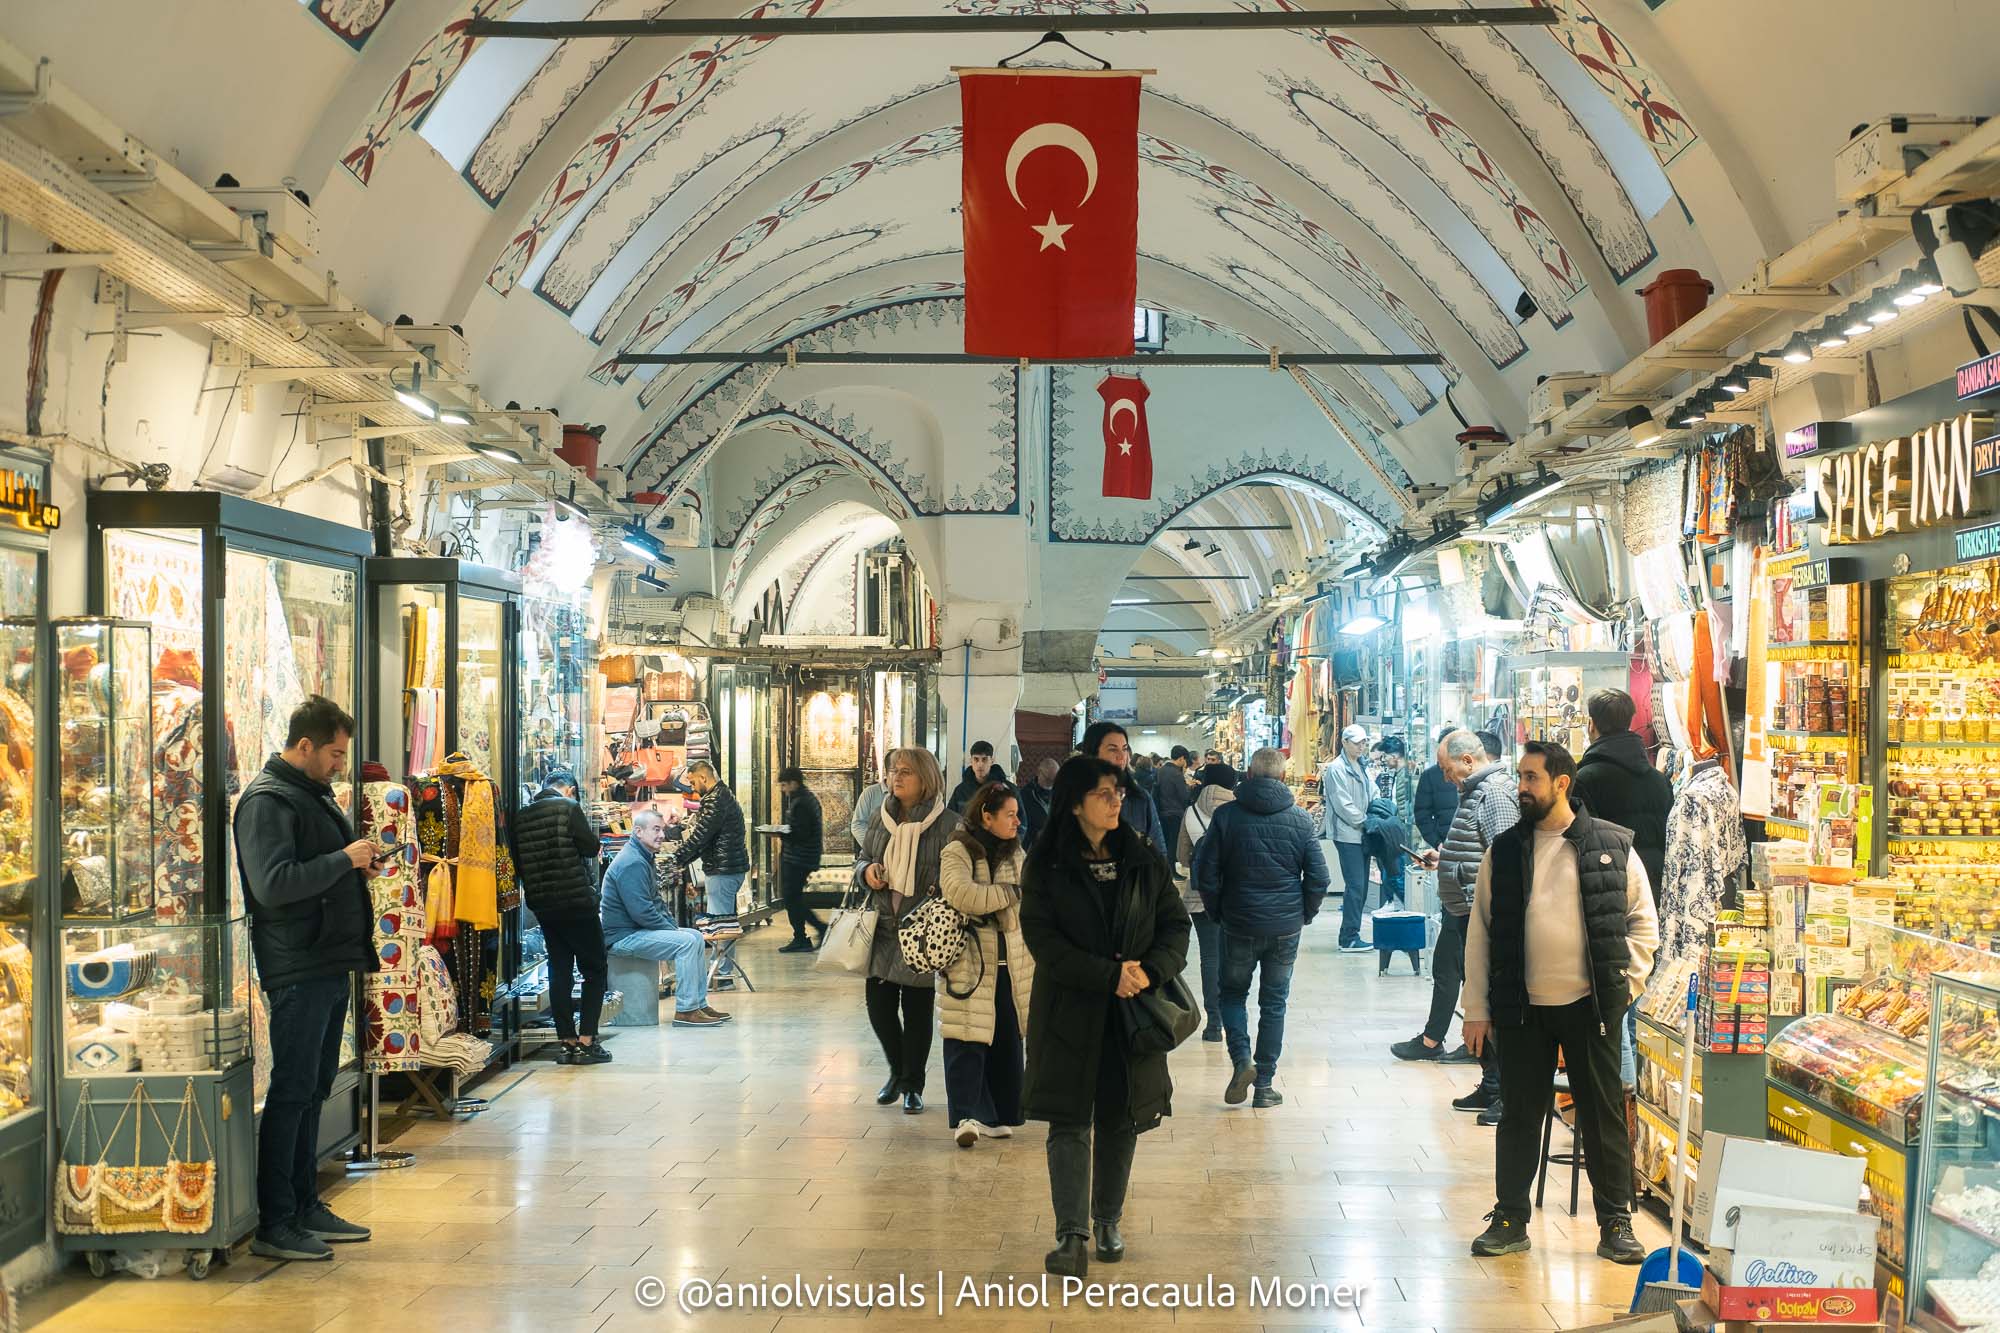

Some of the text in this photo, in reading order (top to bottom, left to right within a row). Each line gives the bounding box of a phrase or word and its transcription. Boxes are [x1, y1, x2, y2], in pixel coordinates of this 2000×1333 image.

[1957, 361, 1988, 397] IRANIAN
[1974, 442, 1994, 472] DRY
[1818, 413, 1973, 546] SPICE INN
[1956, 528, 1989, 560] TURKISH
[1792, 561, 1828, 589] HERBAL TEA
[1745, 1259, 1818, 1287] Goltiva
